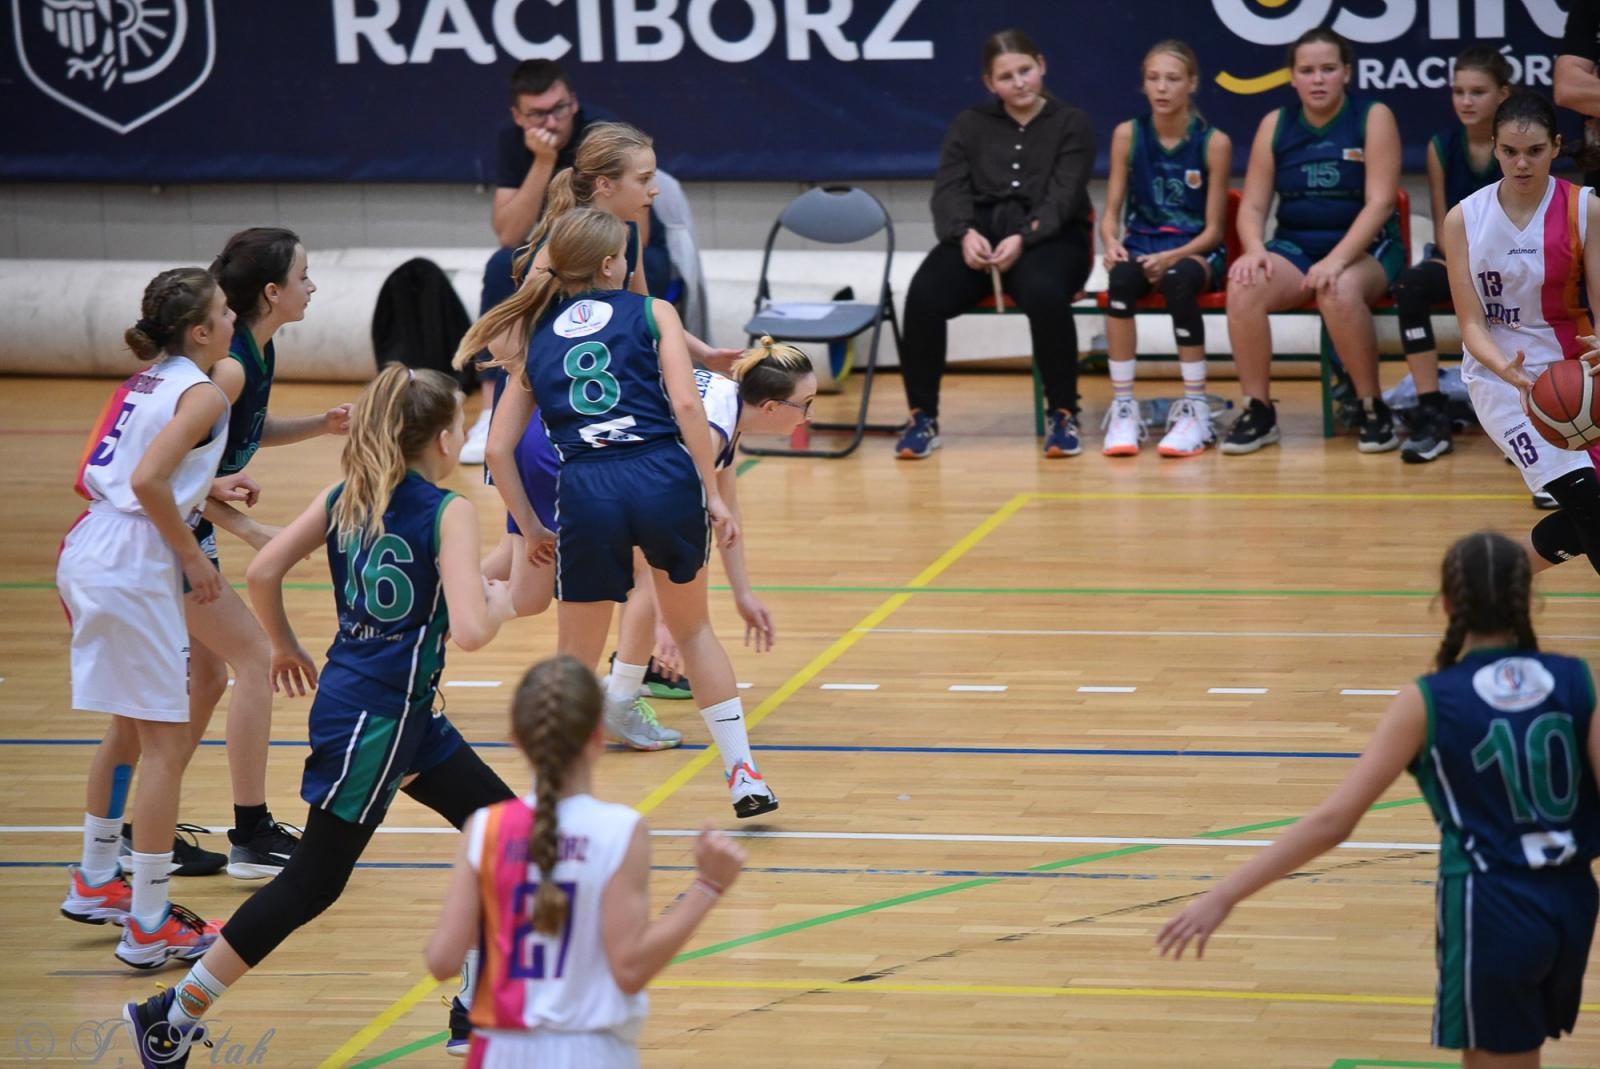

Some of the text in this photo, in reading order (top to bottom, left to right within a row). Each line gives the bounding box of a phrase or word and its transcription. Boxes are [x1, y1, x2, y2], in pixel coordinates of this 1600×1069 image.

[1152, 177, 1184, 206] 12
[1301, 161, 1340, 188] 15
[1478, 271, 1503, 297] 13
[563, 341, 621, 415] 8
[89, 402, 136, 466] 5
[1508, 431, 1539, 468] 13
[338, 527, 414, 622] 16
[1471, 712, 1581, 823] 10
[510, 882, 577, 979] 27
